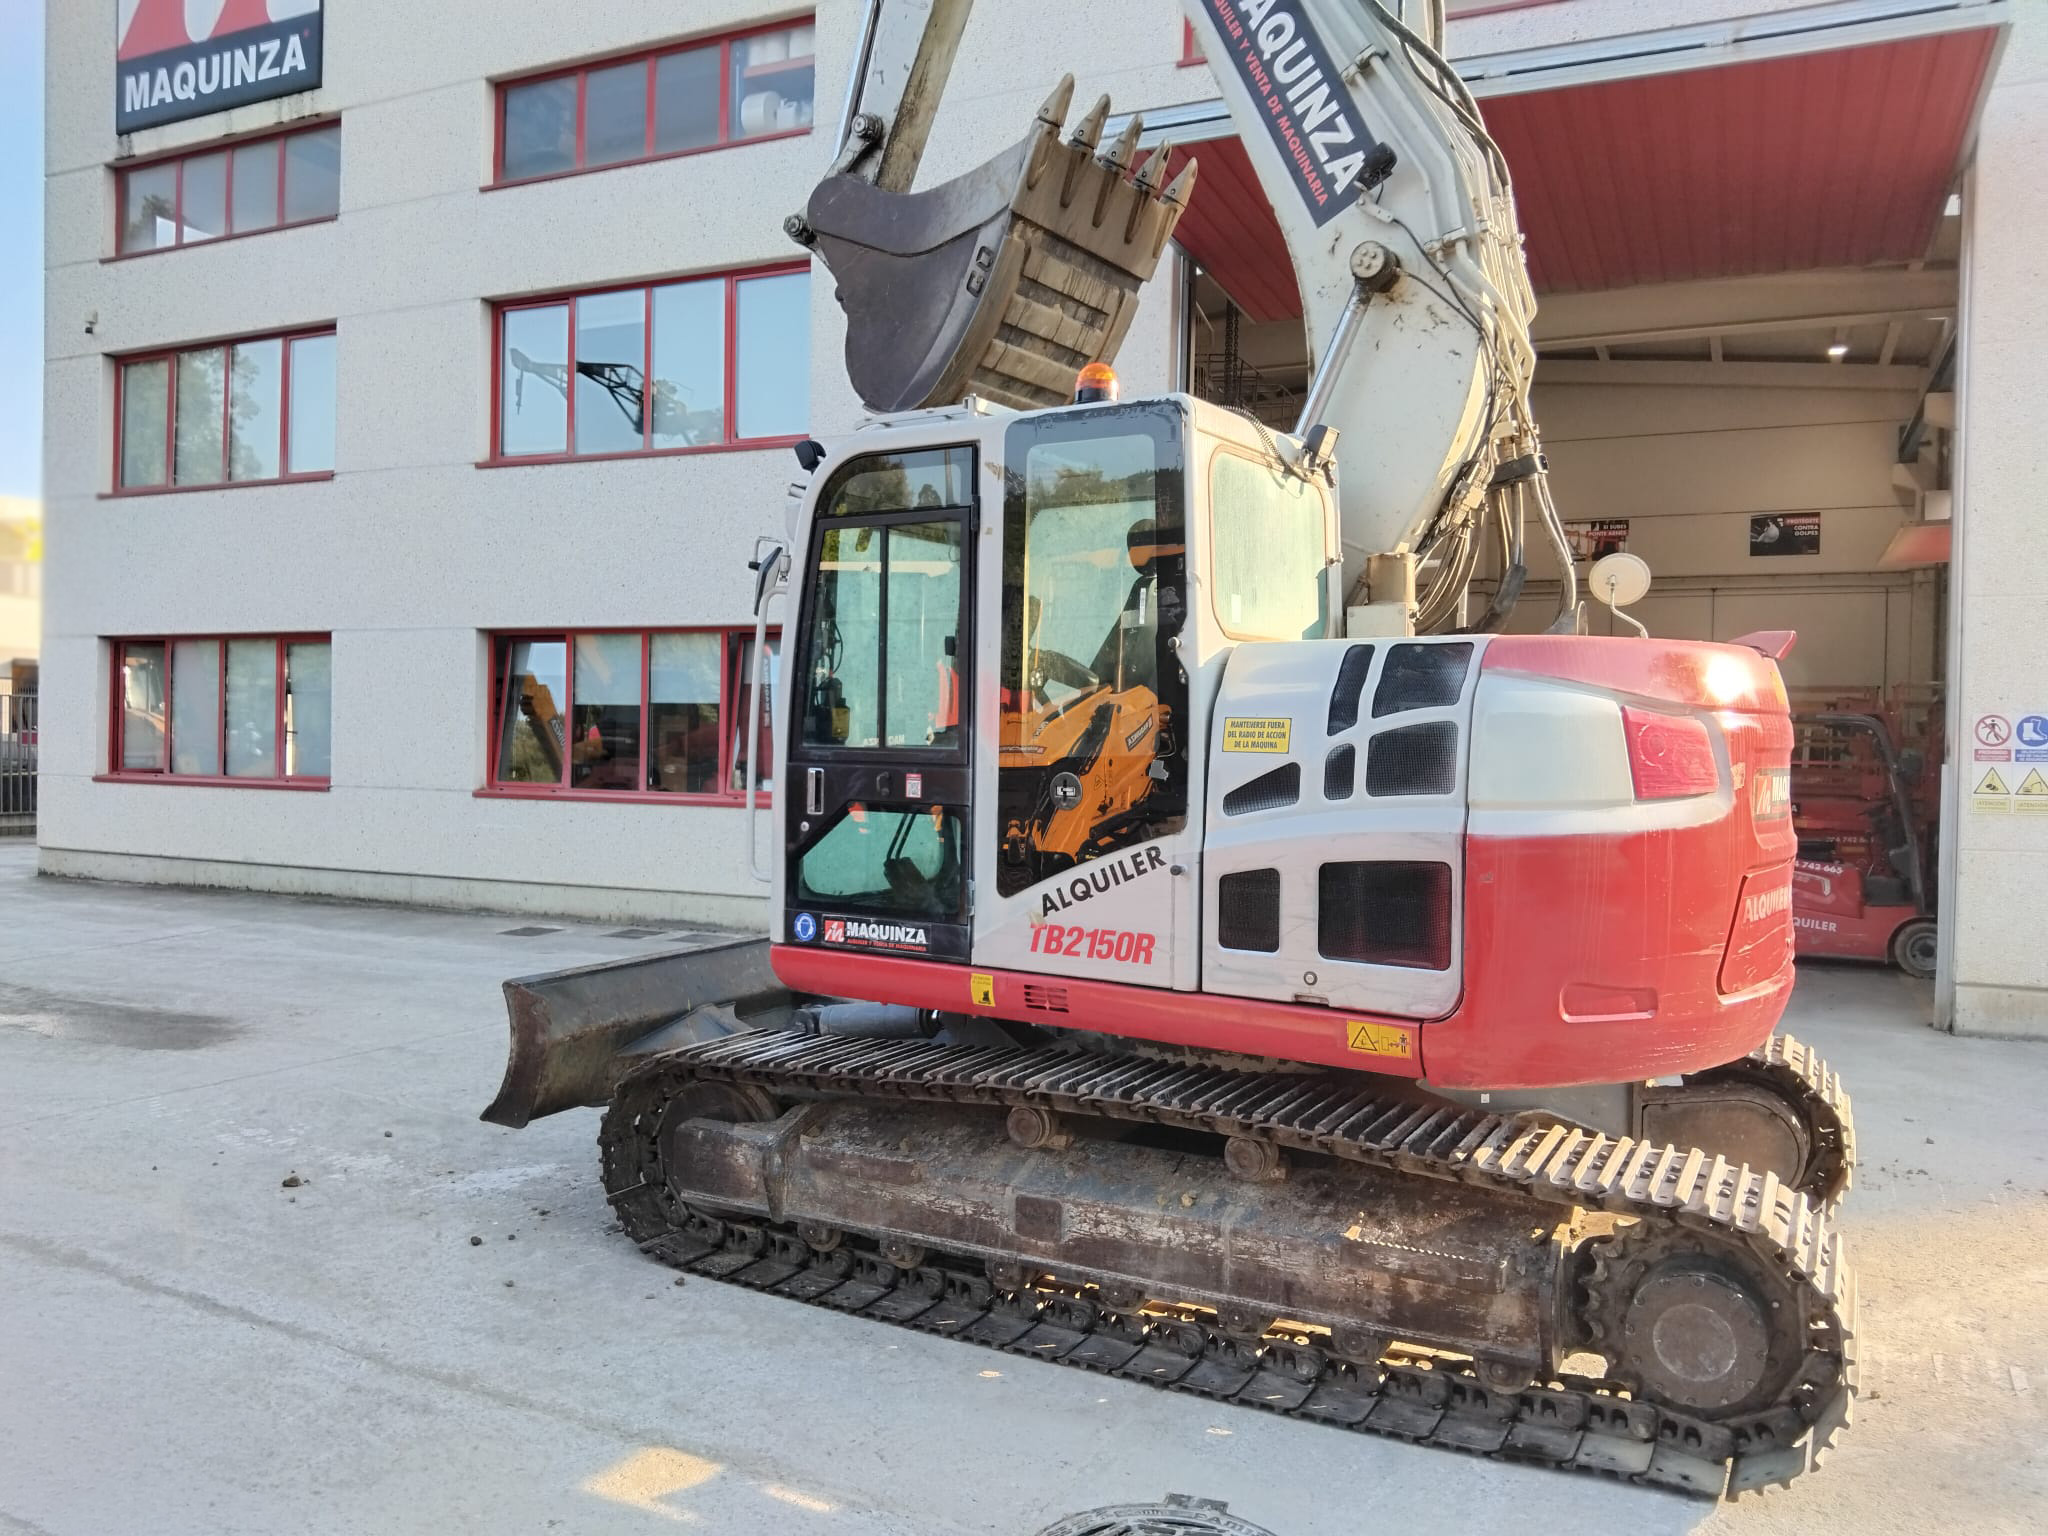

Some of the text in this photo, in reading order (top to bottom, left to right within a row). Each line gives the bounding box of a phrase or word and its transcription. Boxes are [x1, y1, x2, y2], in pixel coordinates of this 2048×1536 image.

[125, 33, 306, 113] MAQUINZA
[1245, 51, 1272, 96] VENTA
[1266, 95, 1284, 116] DE
[1277, 115, 1329, 207] MAQUINARIA
[1231, 721, 1285, 729] MANTENERSE FUERA
[1041, 845, 1167, 918] ALQUILER
[846, 922, 927, 944] MAQUINZA
[1030, 922, 1156, 965] TB2150R
